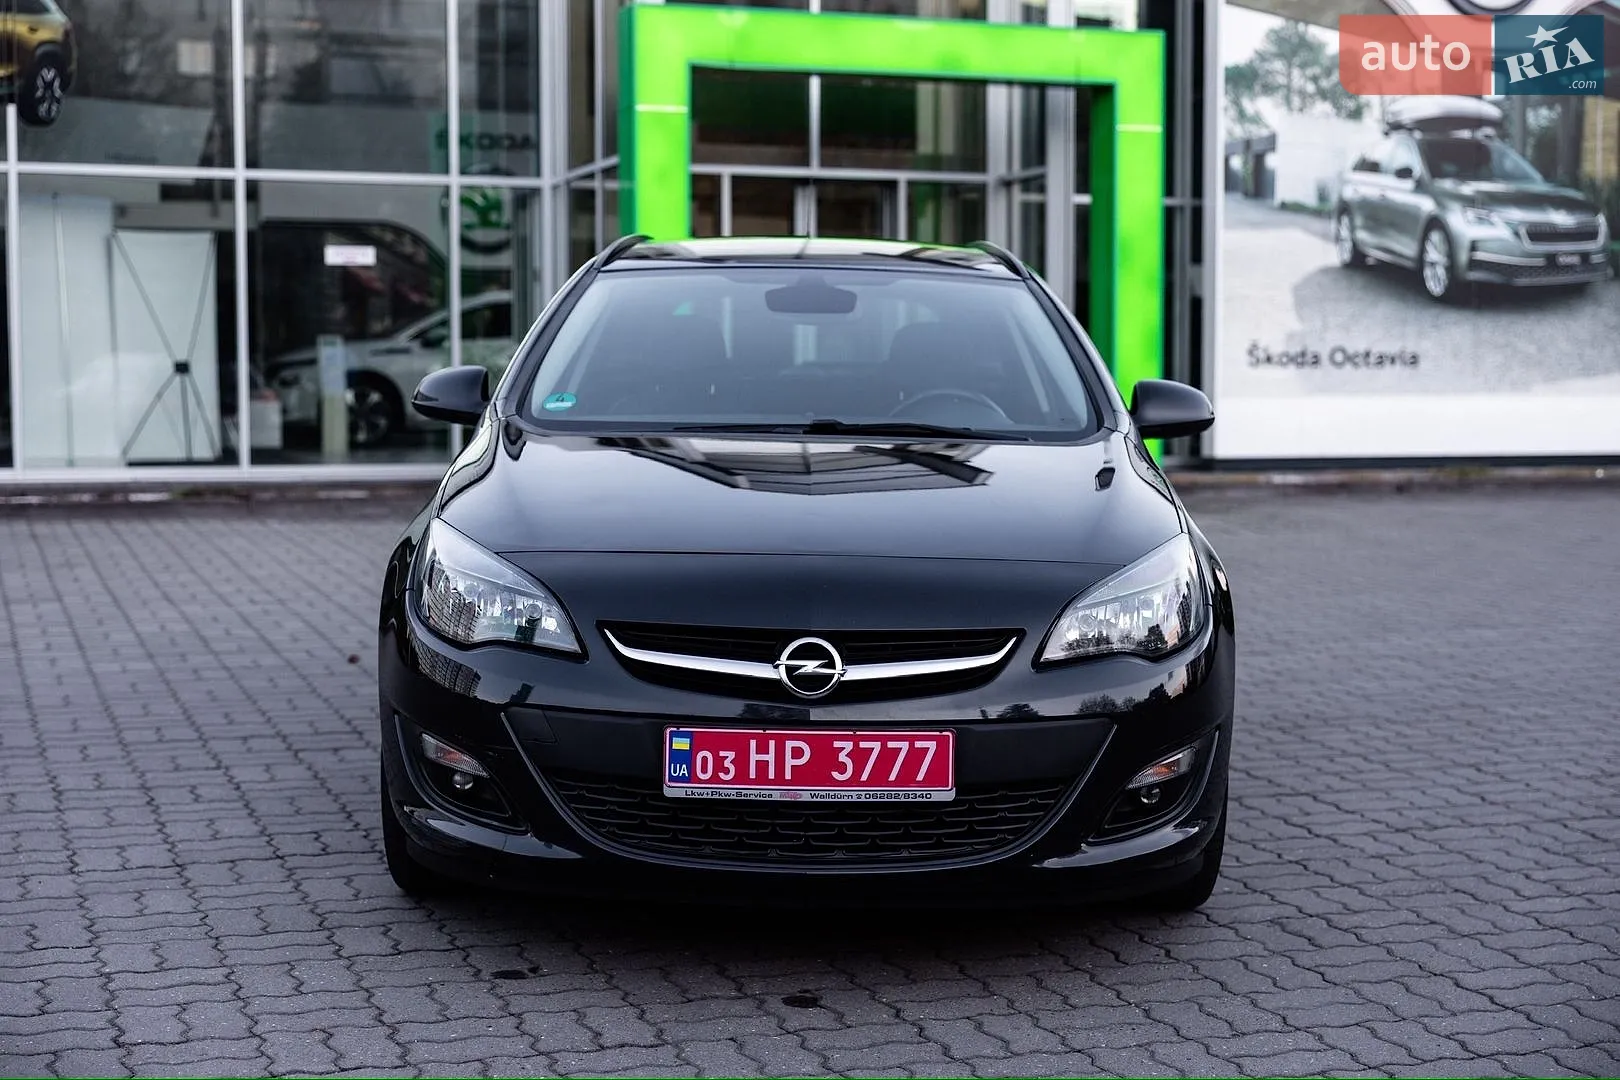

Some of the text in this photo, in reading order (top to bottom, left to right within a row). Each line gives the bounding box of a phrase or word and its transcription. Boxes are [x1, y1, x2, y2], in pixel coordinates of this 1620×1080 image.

[1328, 345, 1420, 369] Octavia
[671, 739, 937, 782] UA 03 HP 3777
